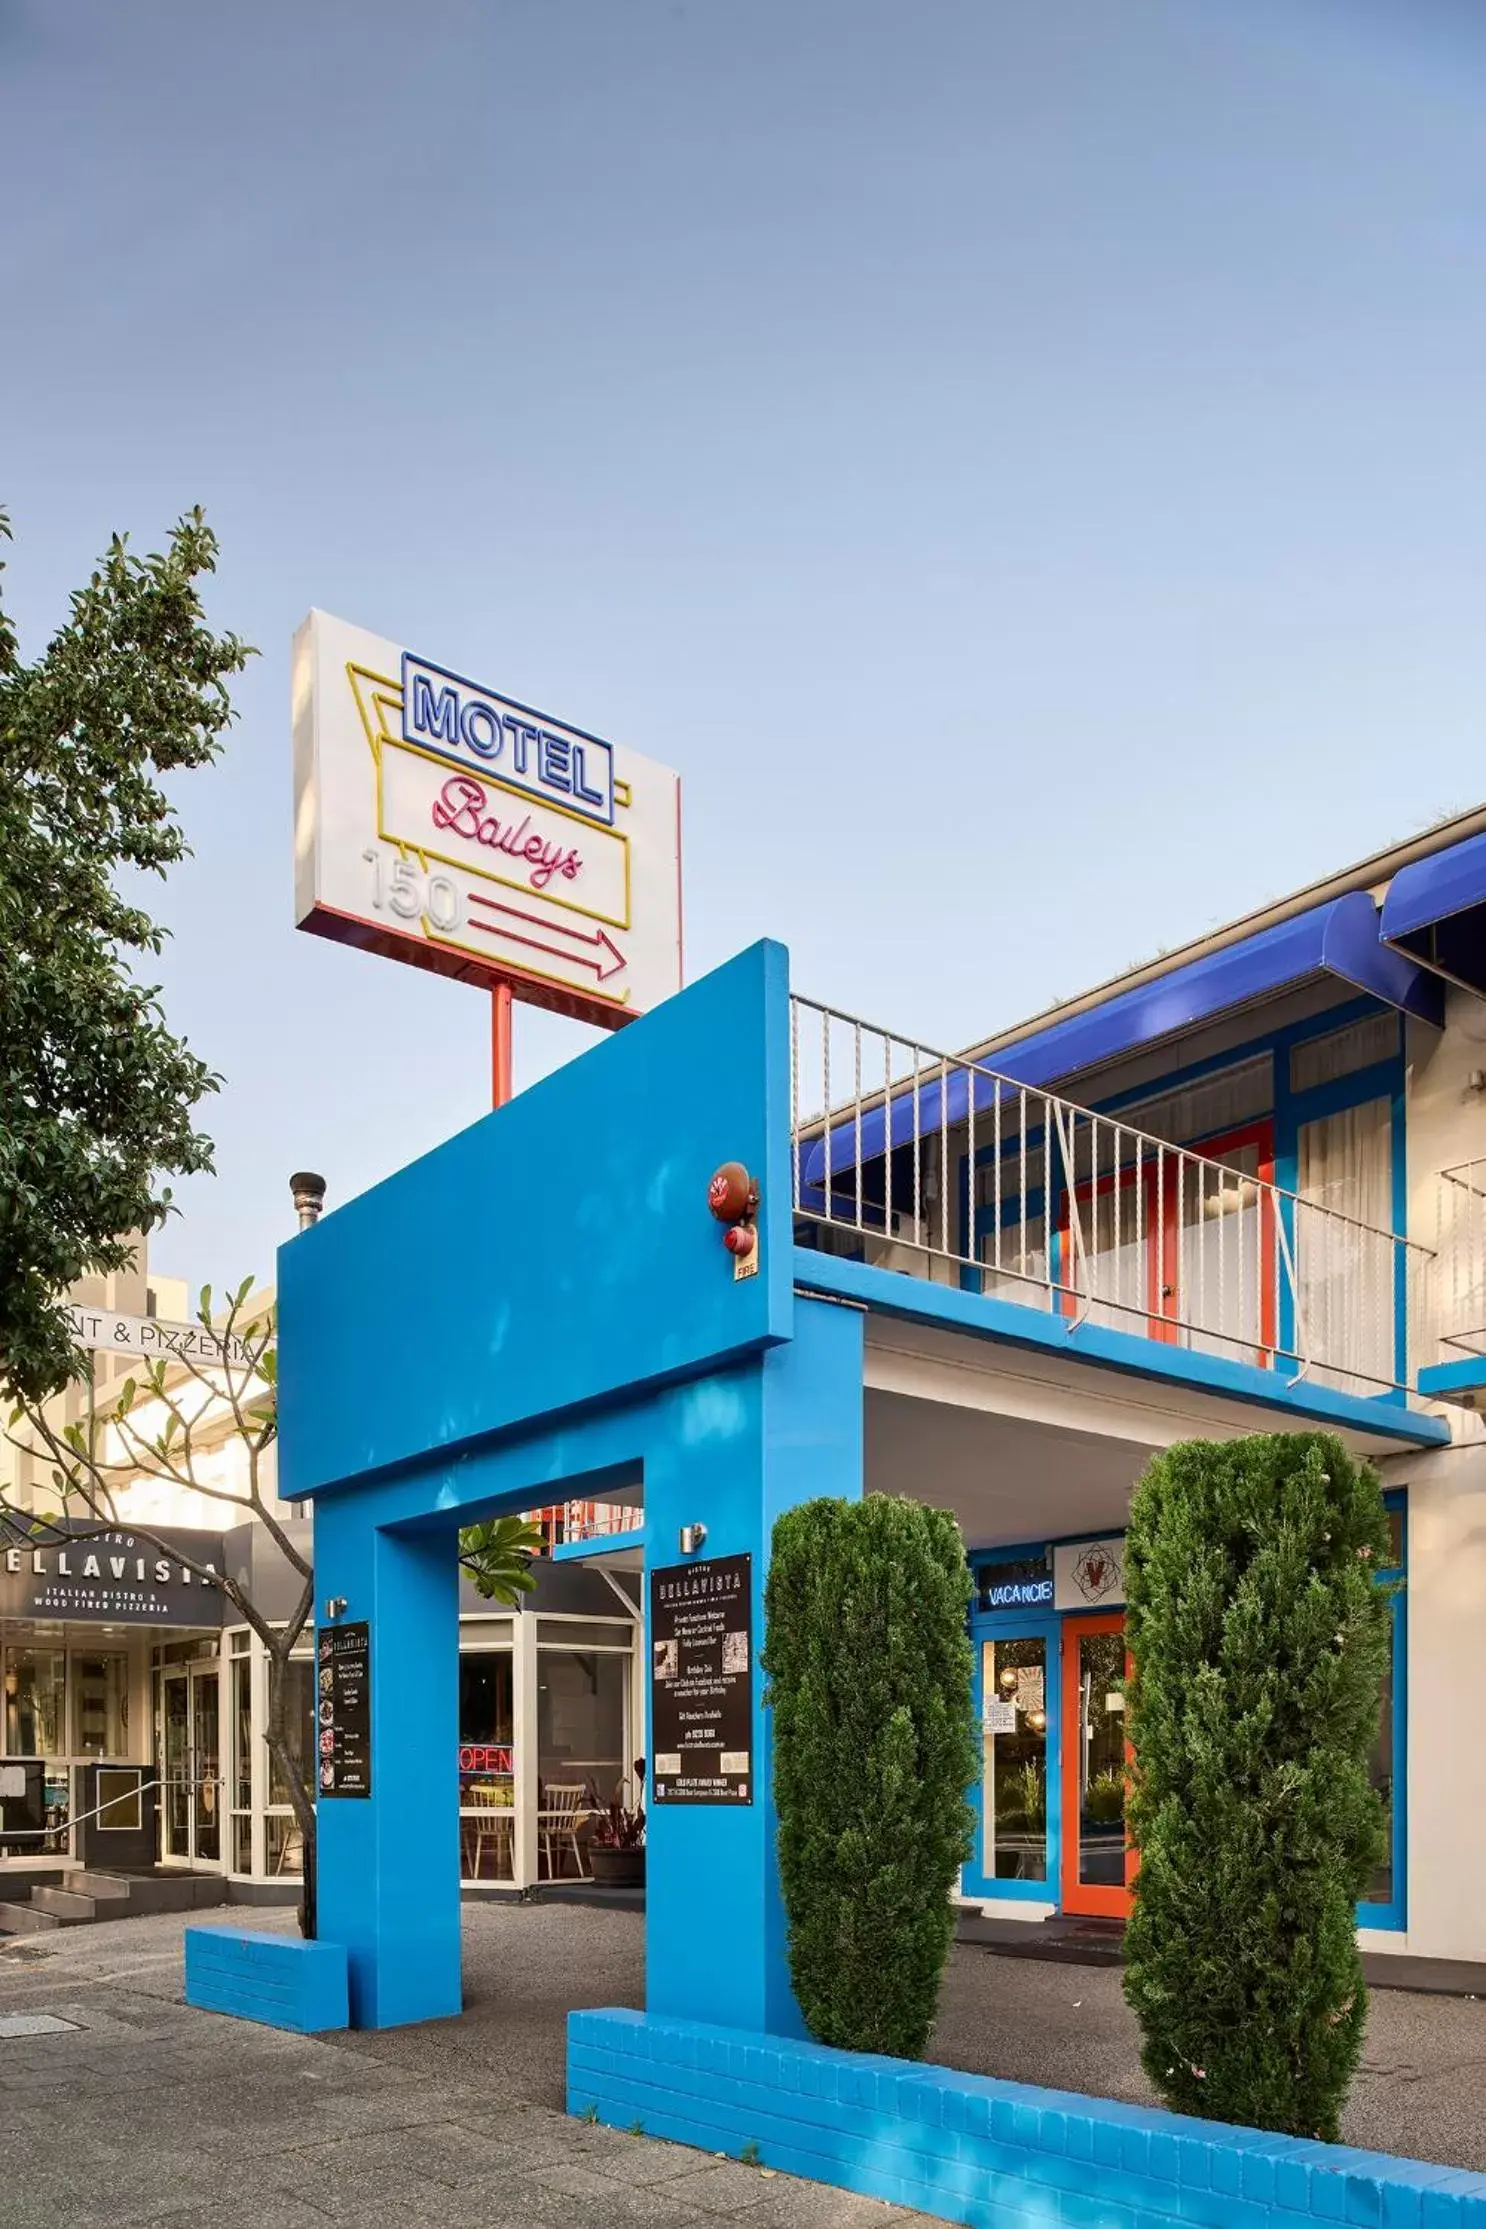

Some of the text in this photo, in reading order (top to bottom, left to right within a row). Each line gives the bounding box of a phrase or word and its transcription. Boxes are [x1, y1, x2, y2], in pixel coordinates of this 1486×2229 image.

[413, 674, 604, 806] MOTEL
[432, 775, 583, 889] Baileys
[362, 848, 461, 933] 150
[738, 1263, 755, 1277] FIRE
[113, 1322, 131, 1343] &
[34, 1597, 168, 1613] WOOD FIRED PIZZERIA
[46, 1587, 95, 1599] ITALIAN
[102, 1590, 144, 1601] BISTRO
[460, 1747, 512, 1772] OPEN
